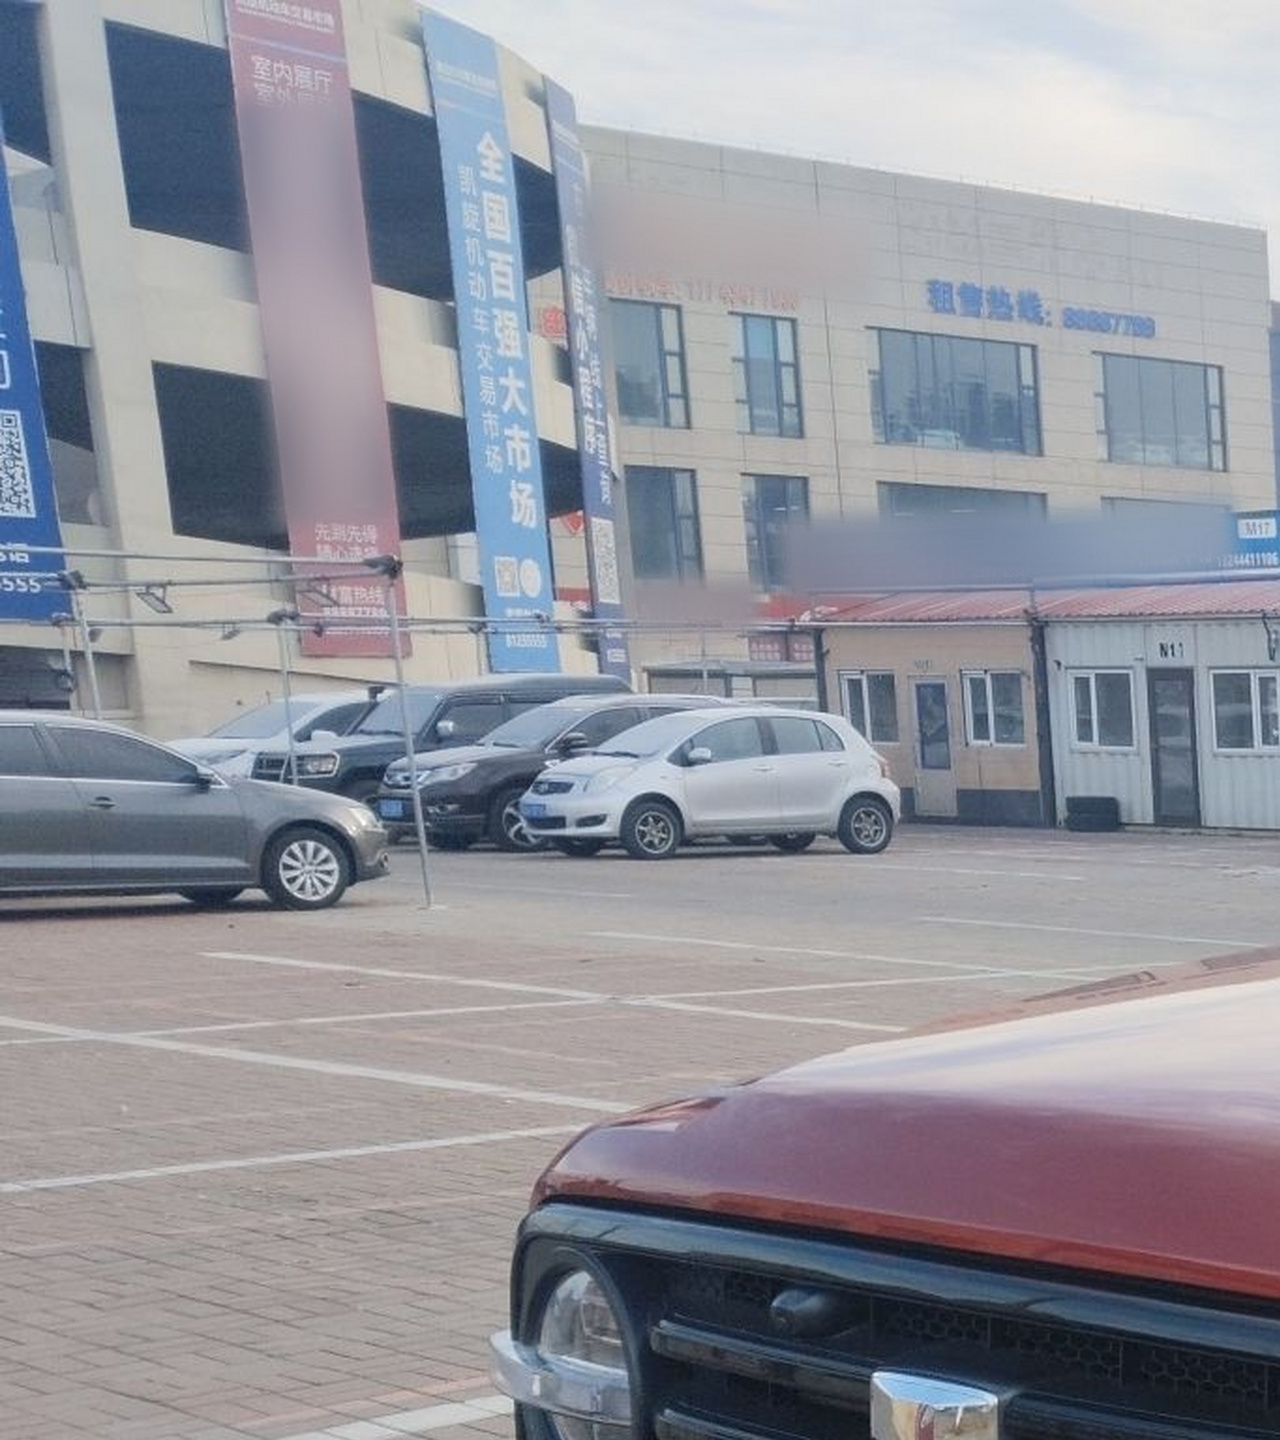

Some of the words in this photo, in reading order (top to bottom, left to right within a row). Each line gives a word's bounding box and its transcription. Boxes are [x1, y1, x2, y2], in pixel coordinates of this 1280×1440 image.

[251, 56, 331, 95] 室内展厅
[457, 164, 503, 475] 凯旋机动车交易市场
[477, 131, 537, 529] 全国百强大市场
[315, 524, 377, 544] 先到先得
[0, 576, 42, 593] 555
